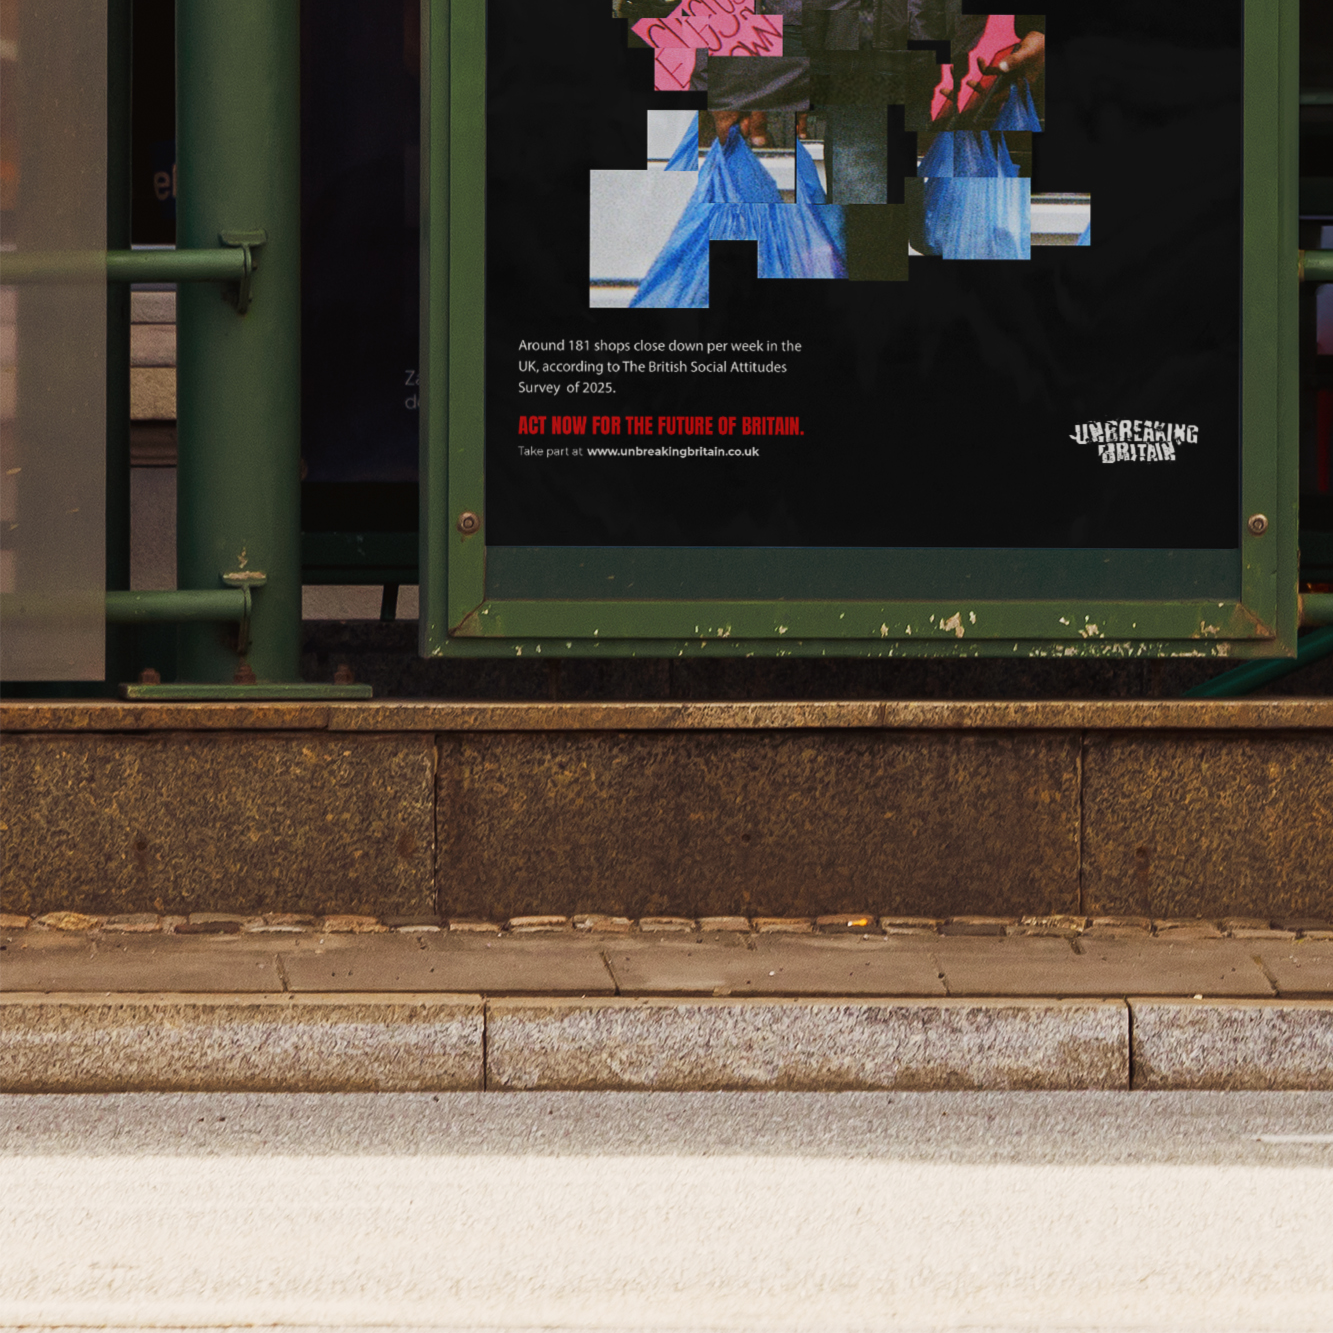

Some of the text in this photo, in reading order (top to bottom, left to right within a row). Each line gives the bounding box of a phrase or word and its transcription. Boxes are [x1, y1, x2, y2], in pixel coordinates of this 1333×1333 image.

[518, 338, 802, 355] Around 181 shops close down per week in the
[518, 360, 788, 376] UK, according to The British Social Attitudes
[518, 380, 616, 396] Survey of 2025.
[517, 415, 805, 436] ACT NOW FOR THE FUTURE OF BRITAIN.
[1068, 419, 1199, 446] UNBREAKING
[518, 445, 760, 459] Take part at www.unbreakingbritain.co.uk
[1097, 441, 1177, 464] BRITAIN
